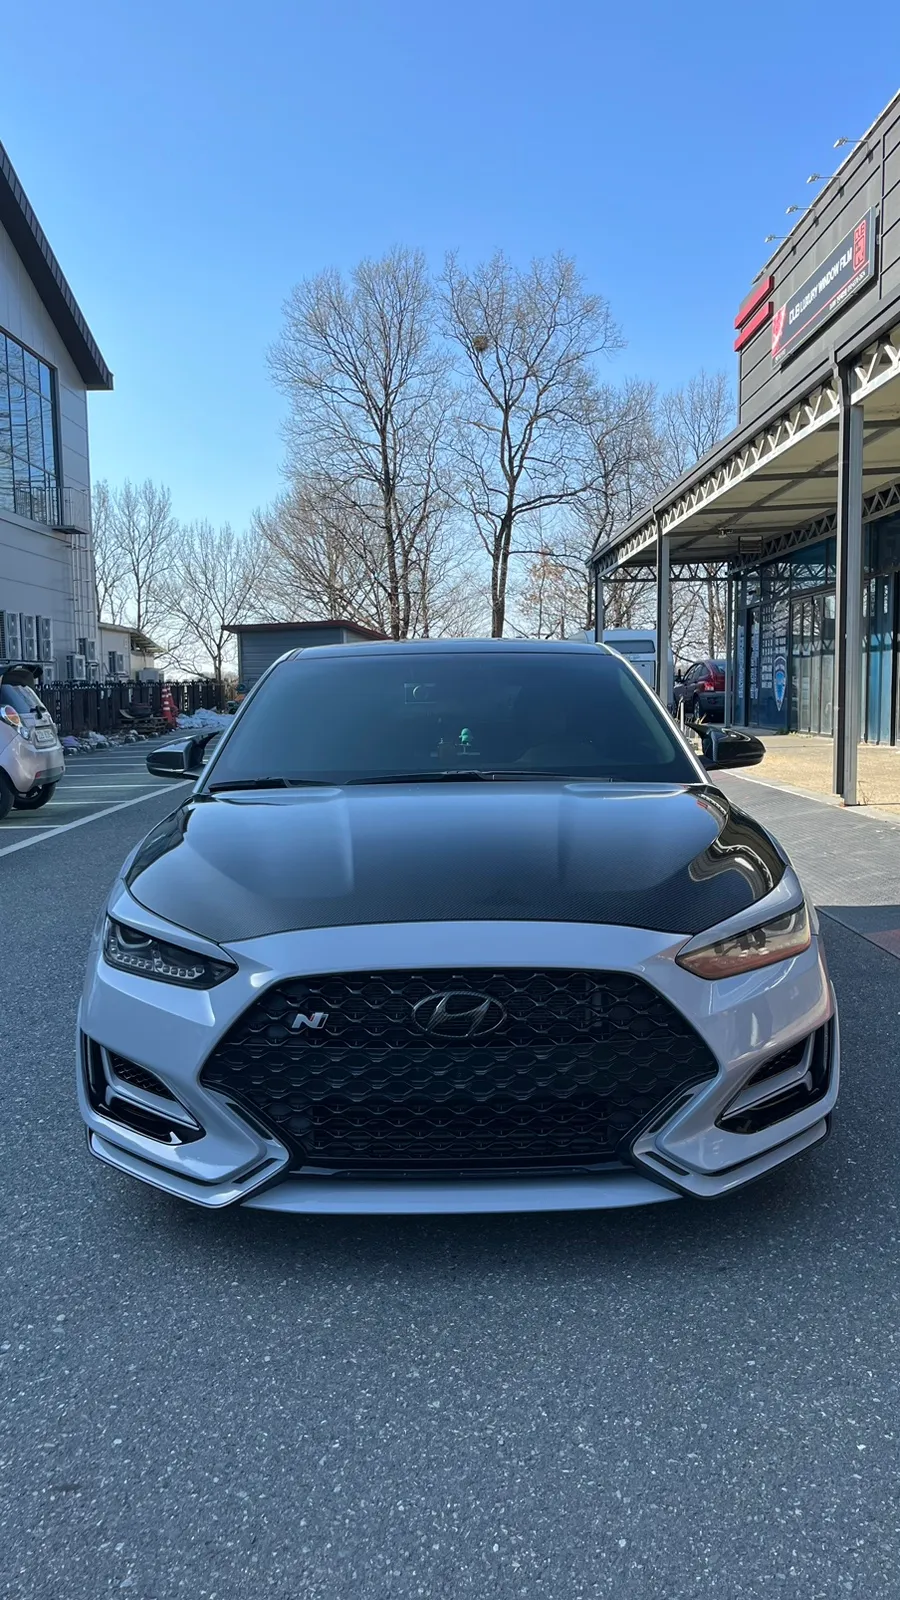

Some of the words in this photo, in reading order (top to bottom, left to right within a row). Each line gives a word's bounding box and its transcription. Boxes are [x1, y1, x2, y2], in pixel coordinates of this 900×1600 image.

[818, 261, 839, 294] WINDOW
[839, 247, 853, 271] FILM
[291, 1012, 329, 1029] N
